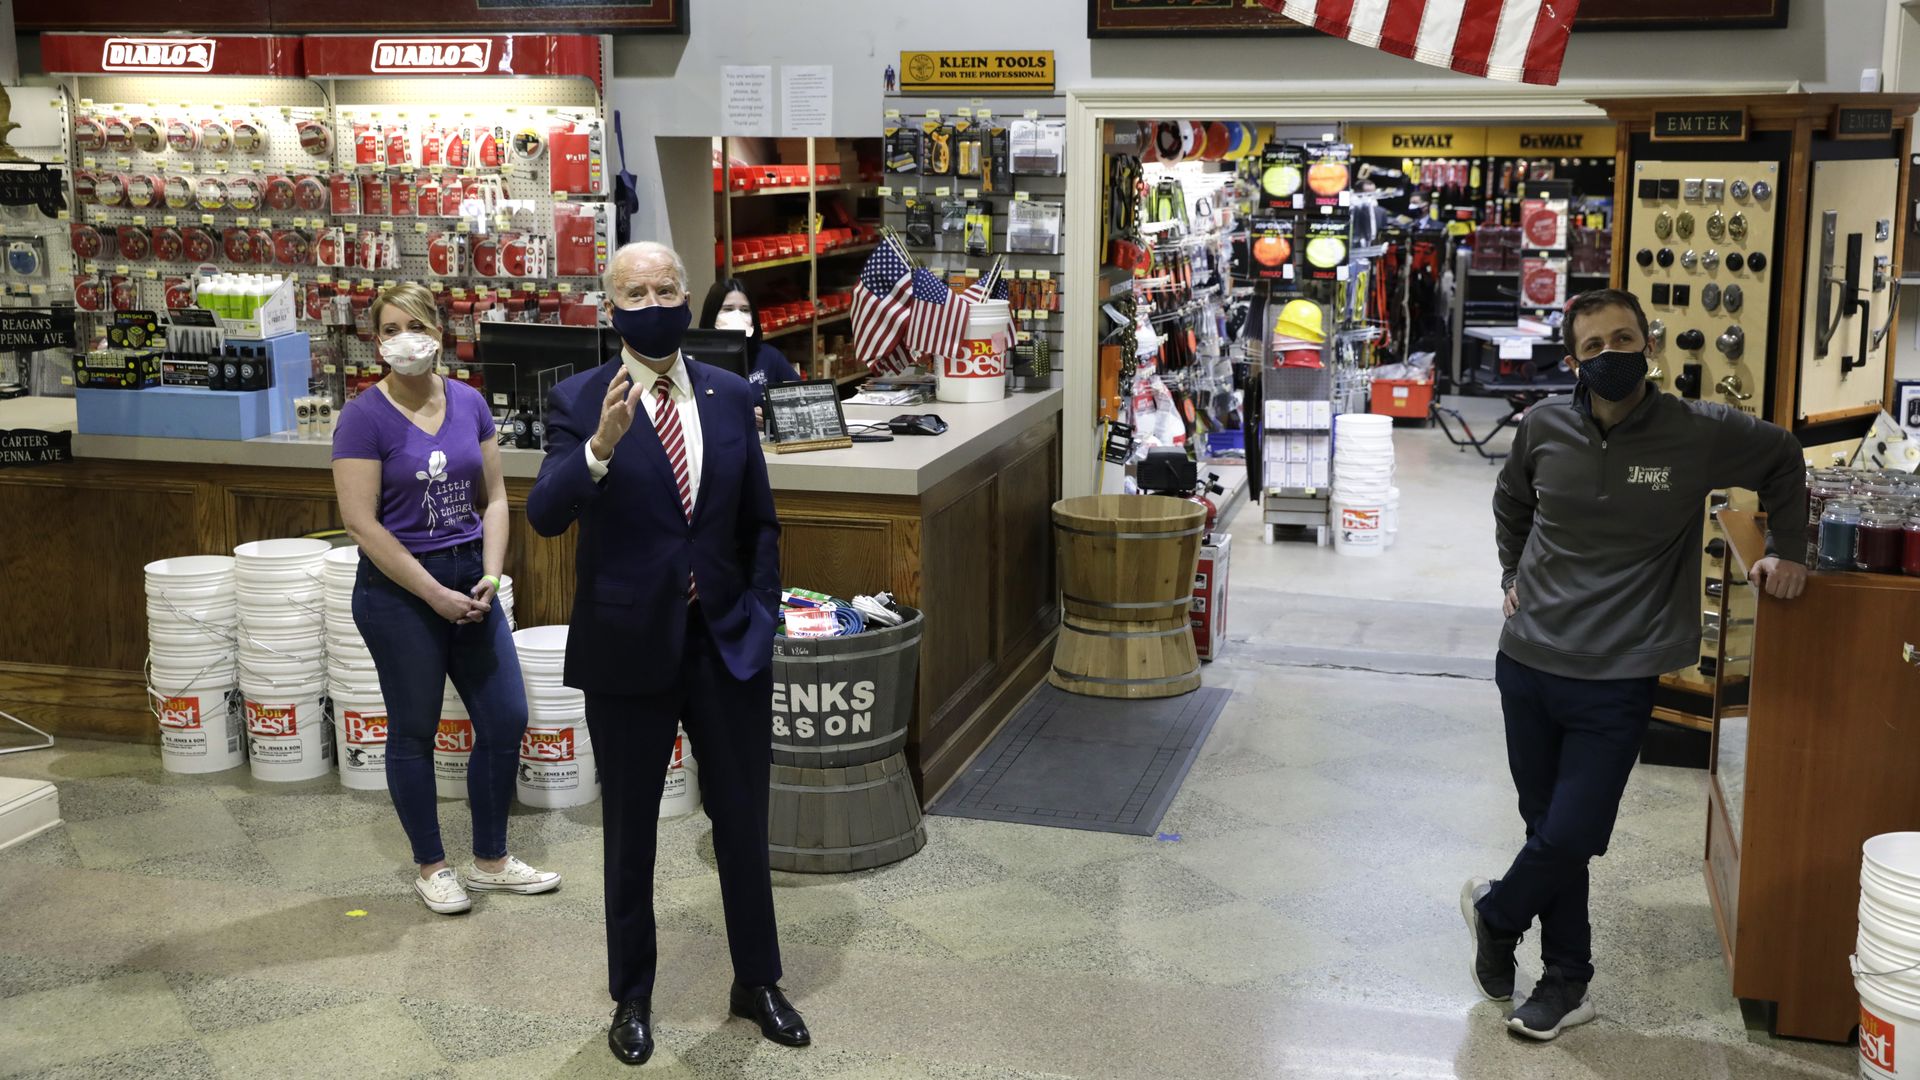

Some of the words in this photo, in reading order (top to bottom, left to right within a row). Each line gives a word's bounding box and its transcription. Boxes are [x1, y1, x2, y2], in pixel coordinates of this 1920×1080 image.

[110, 44, 186, 65] DIABLO
[379, 45, 461, 66] DIABLO
[939, 56, 988, 68] KLEIN
[995, 56, 1046, 68] TOOLS
[1667, 116, 1730, 131] EMTEK
[1848, 113, 1887, 129] EMTEK
[2, 318, 52, 331] REAGAN'S
[0, 333, 38, 345] PENNA.
[43, 332, 67, 344] AVE.
[947, 346, 1006, 376] Best
[748, 371, 765, 384] ENKS
[1, 435, 49, 448] CARTERS
[1627, 465, 1669, 483] JENKS
[435, 479, 471, 496] little
[441, 490, 466, 505] wild
[440, 502, 472, 517] things
[443, 517, 456, 527] city
[772, 680, 876, 713] ENKS
[157, 698, 199, 727] Best
[246, 706, 295, 735] Best
[346, 717, 388, 742] Be
[434, 729, 471, 751] est
[520, 732, 572, 760] Best
[1859, 1024, 1891, 1067] est
